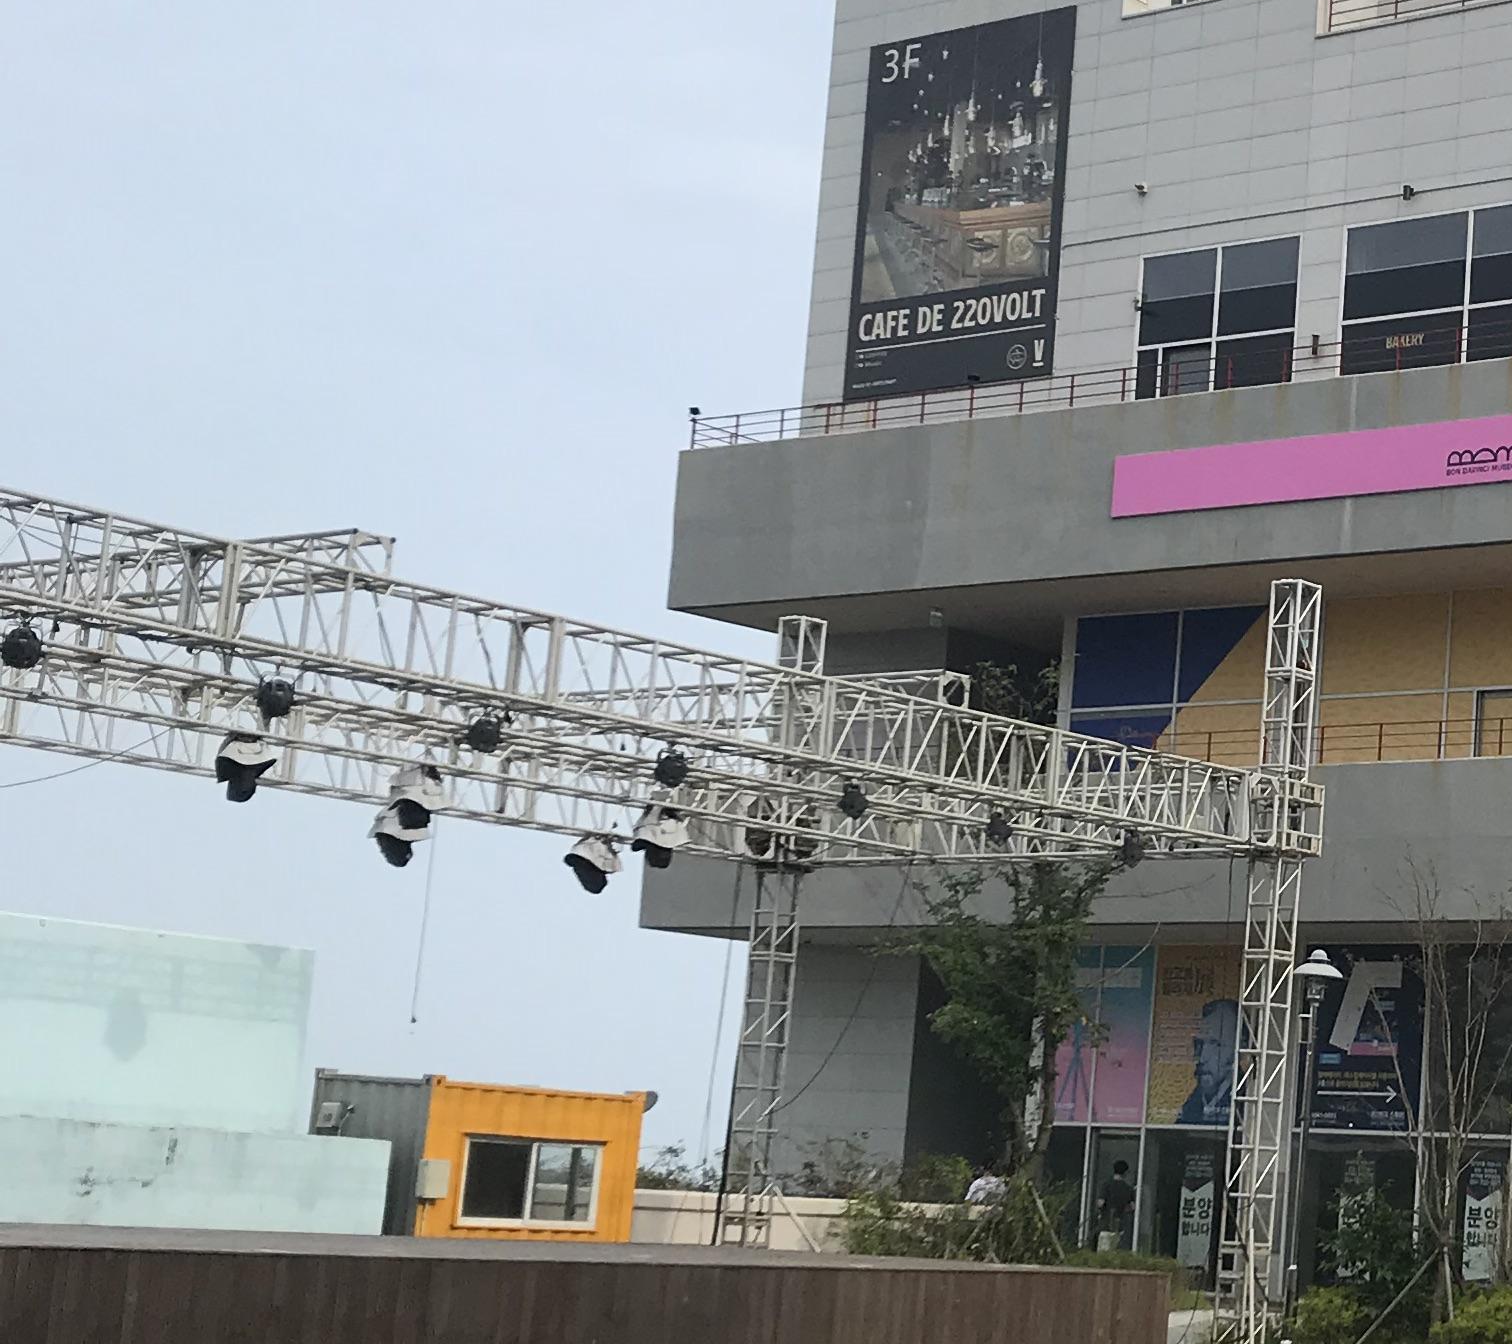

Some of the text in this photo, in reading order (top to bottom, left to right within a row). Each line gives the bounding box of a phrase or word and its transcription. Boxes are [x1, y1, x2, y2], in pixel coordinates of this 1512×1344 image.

[881, 43, 922, 82] 3F
[859, 288, 1046, 341] CAFE DE 220VOLT
[1386, 333, 1425, 349] BAKERY
[1183, 1197, 1212, 1219] 분양
[1182, 1221, 1210, 1236] 합니다
